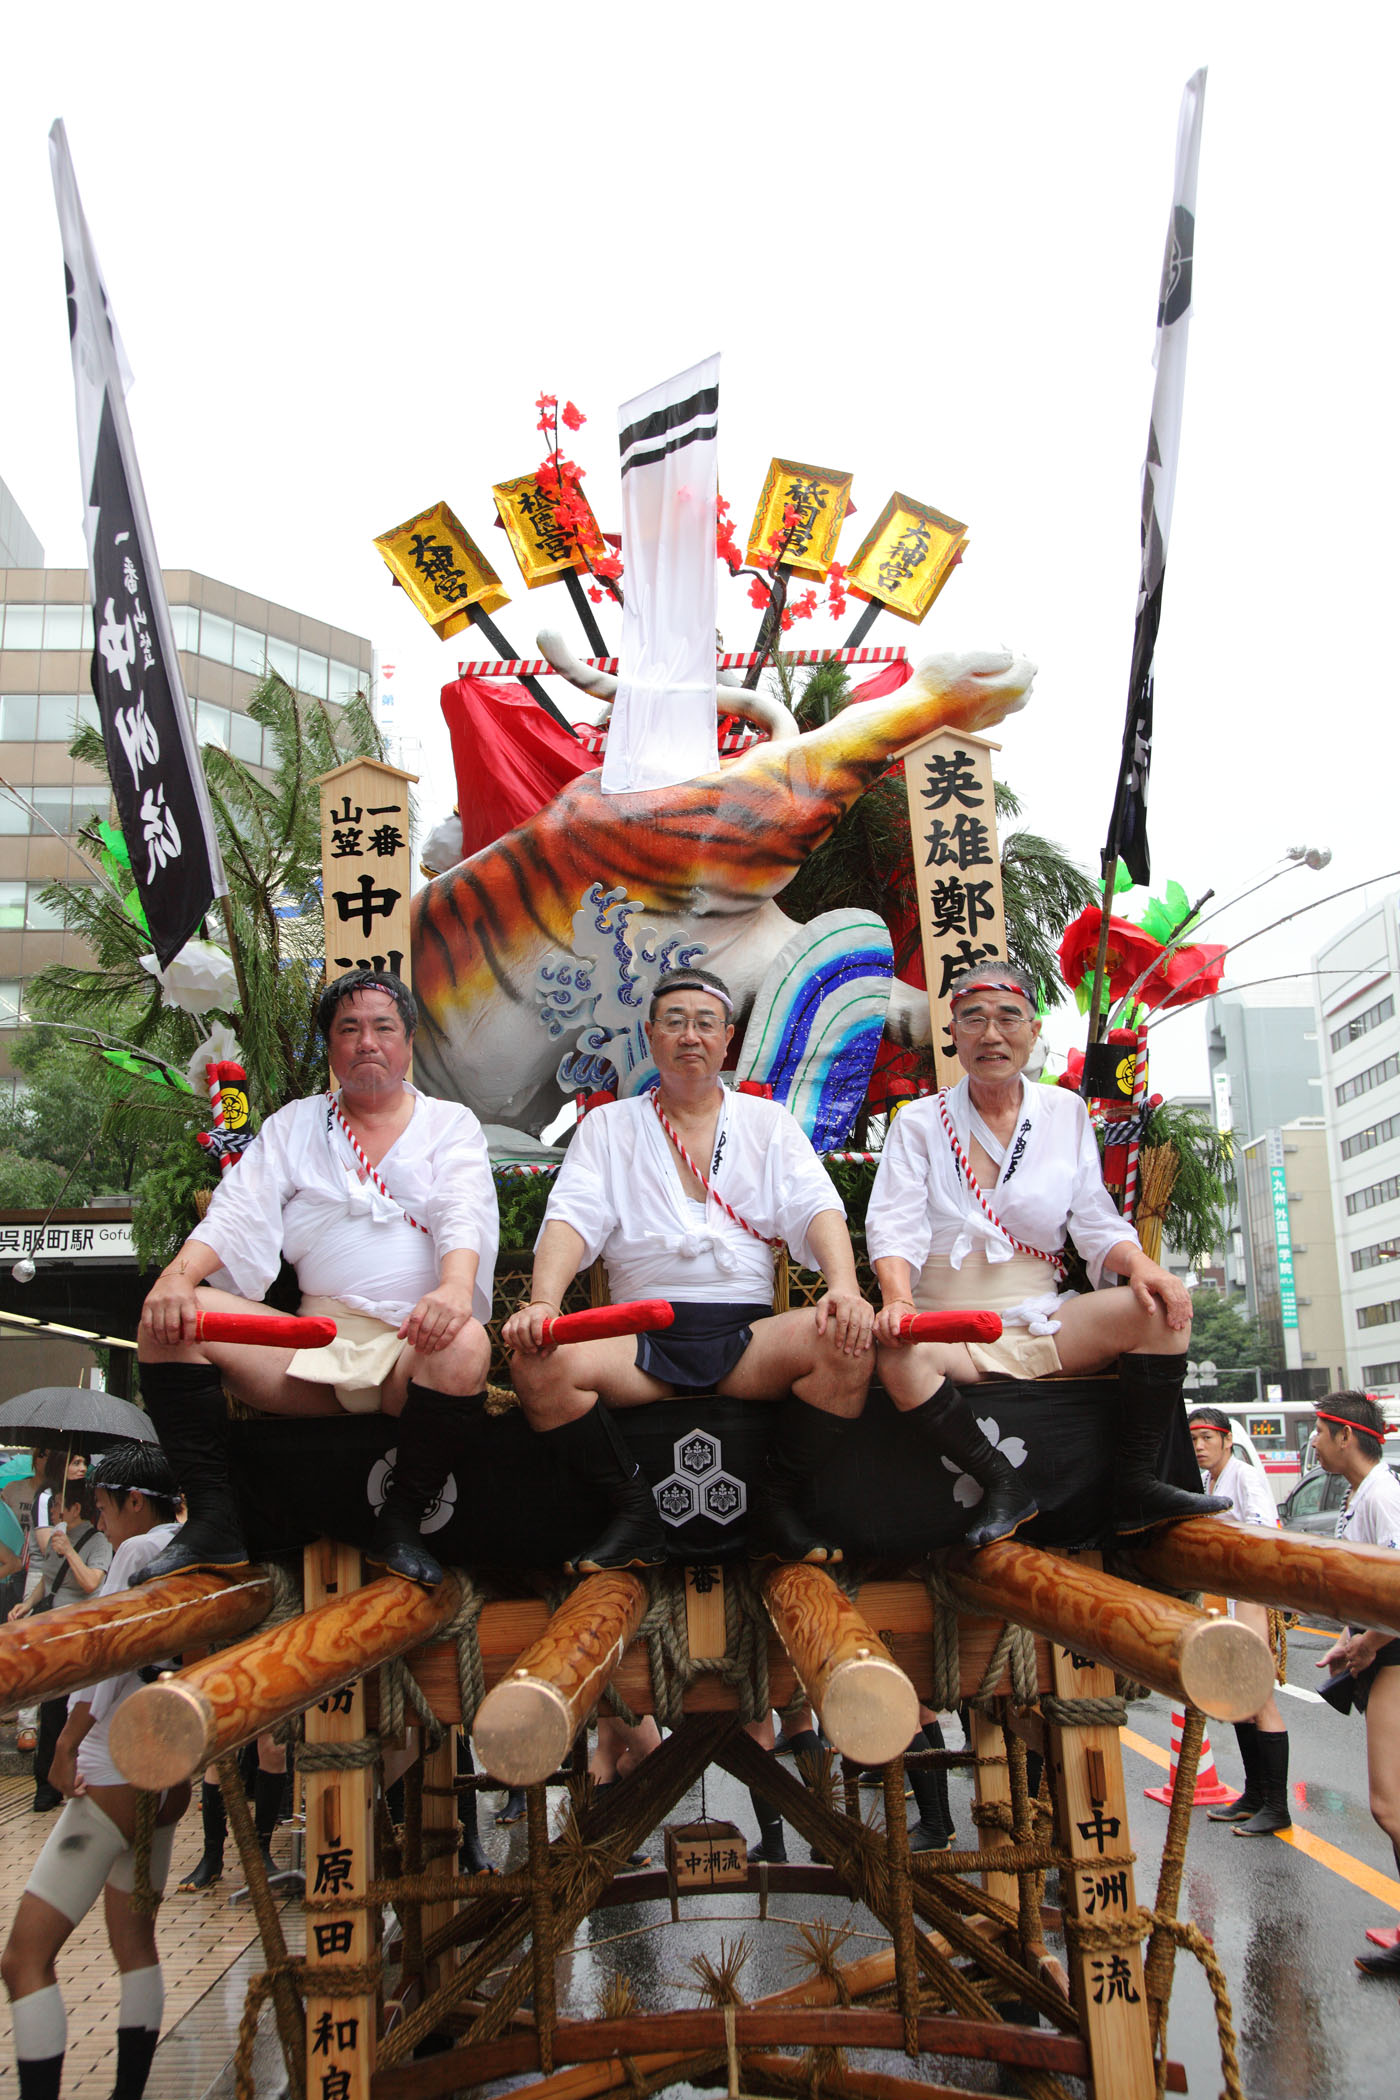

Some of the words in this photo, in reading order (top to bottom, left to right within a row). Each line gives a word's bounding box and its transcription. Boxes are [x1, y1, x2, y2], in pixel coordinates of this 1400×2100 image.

[408, 534, 468, 603] 大神宮
[877, 519, 931, 593] 大神宮
[920, 750, 999, 1058] 英雄鄭成
[684, 1848, 742, 1876] 中洲流
[1076, 1809, 1141, 2005] 中洲流
